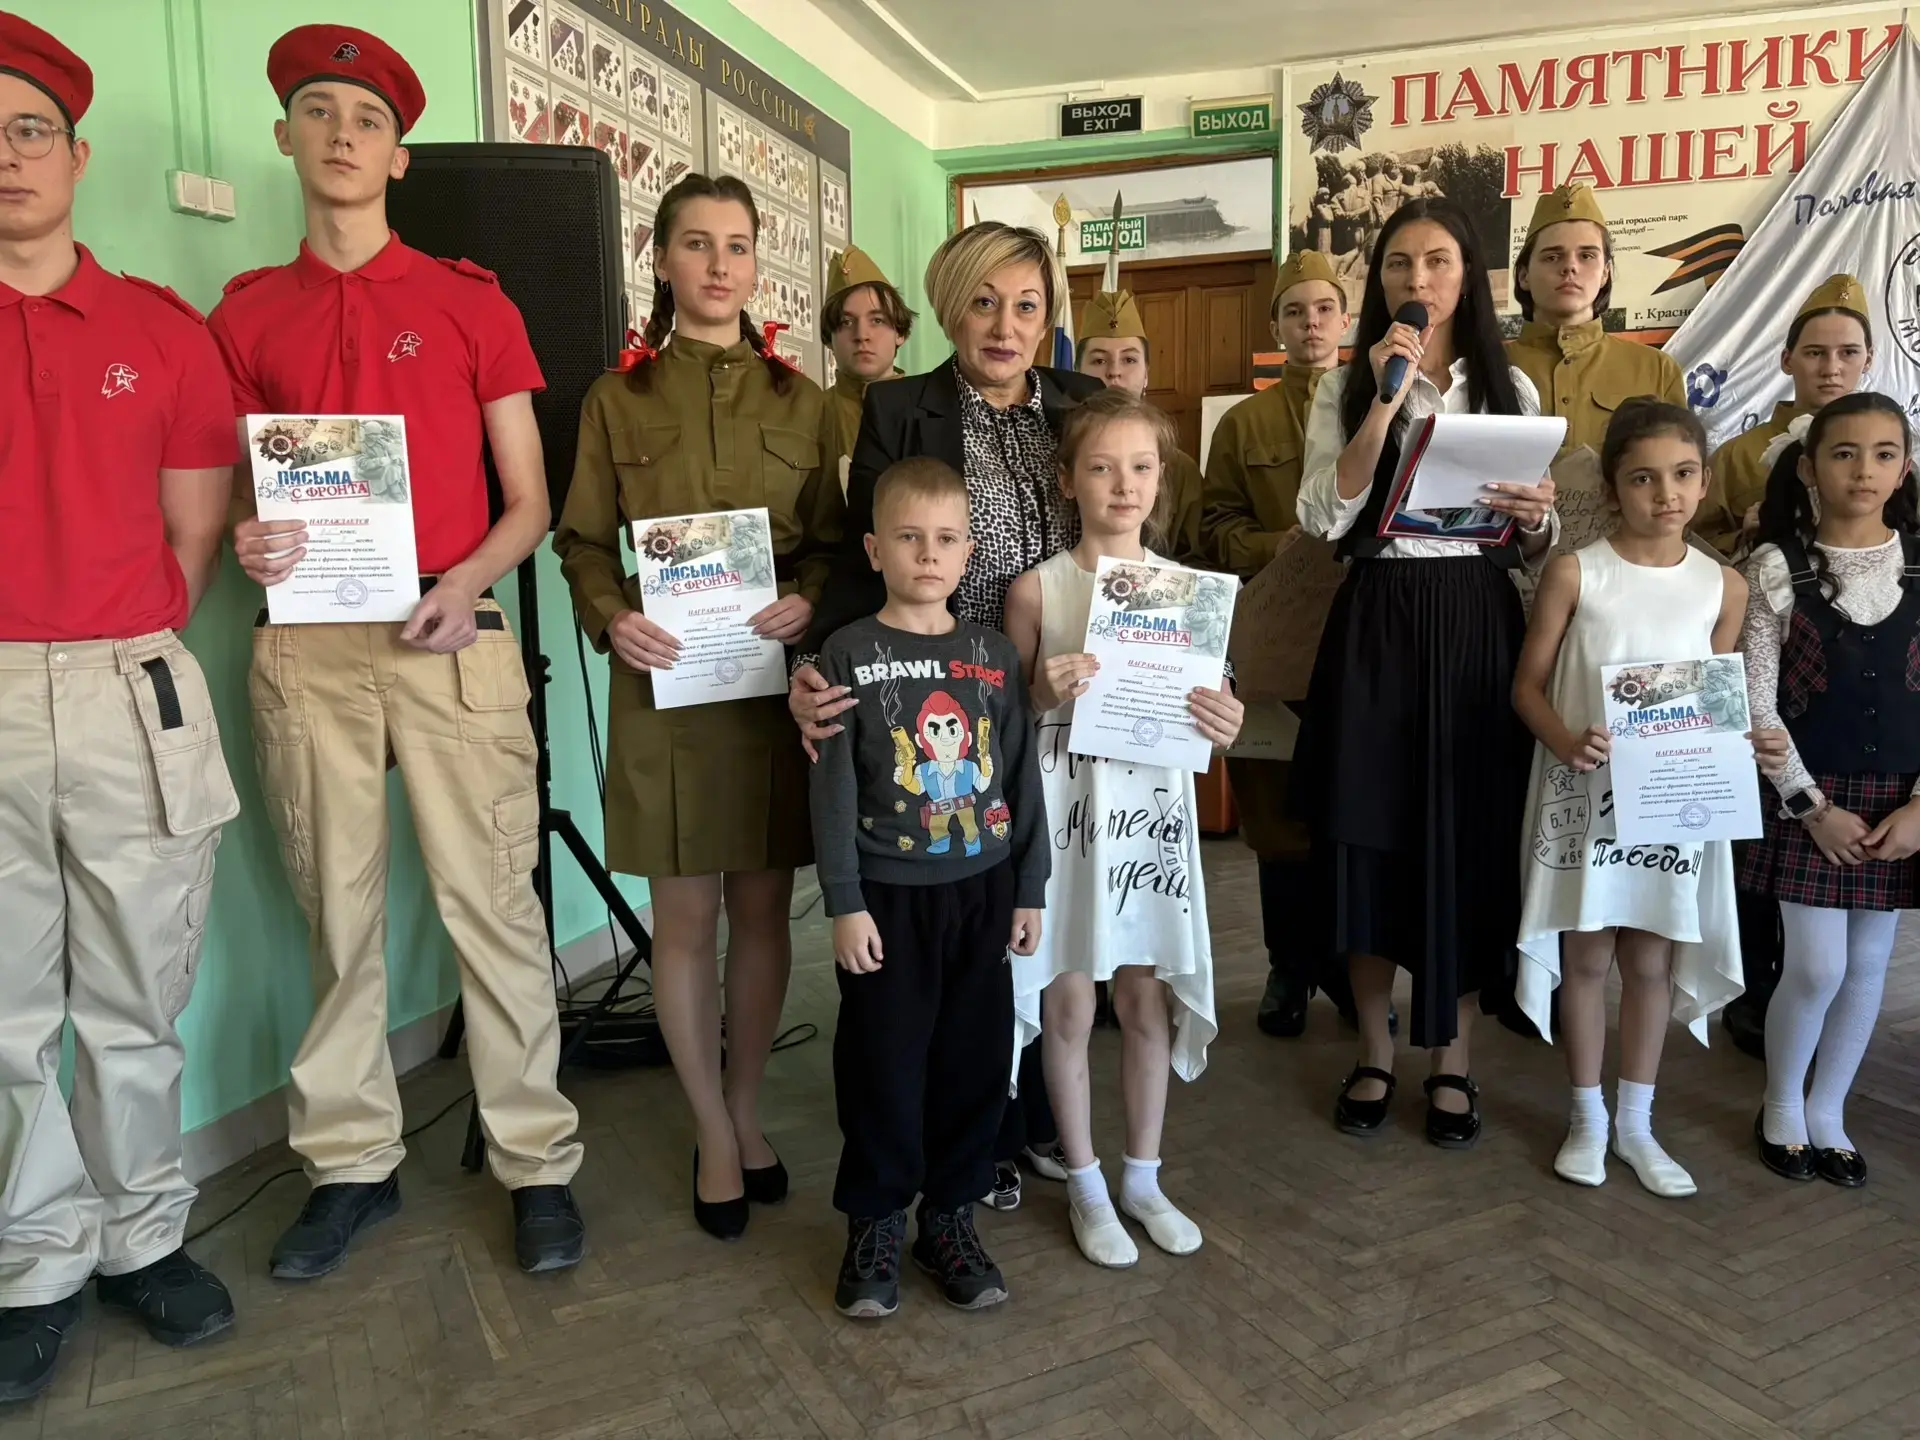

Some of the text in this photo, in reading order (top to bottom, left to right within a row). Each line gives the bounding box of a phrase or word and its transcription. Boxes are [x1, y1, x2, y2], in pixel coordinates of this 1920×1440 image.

[595, 0, 800, 131] АГРАДЫ РОССИИ
[1390, 24, 1905, 127] ПАМЯТНИКИ
[1071, 103, 1132, 119] ВЫХОД
[1199, 110, 1265, 131] ВЫХОД
[1083, 117, 1119, 132] EXIT
[1500, 100, 1811, 198] НАШЕЙ
[1625, 215, 1667, 225] городской
[1668, 214, 1689, 223] парк
[277, 471, 352, 485] ПИСЬМА
[292, 483, 368, 499] С ФРОНТА
[659, 563, 725, 582] ПИСЬМА
[672, 572, 739, 593] С ФРОНТА
[1111, 611, 1177, 632] ПИСЬМА
[1120, 629, 1189, 644] С ФРОНТА
[854, 659, 1006, 689] BRAWL STARS
[1627, 705, 1696, 724] ПИСЬМА
[1640, 715, 1711, 735] С ФРОНТА
